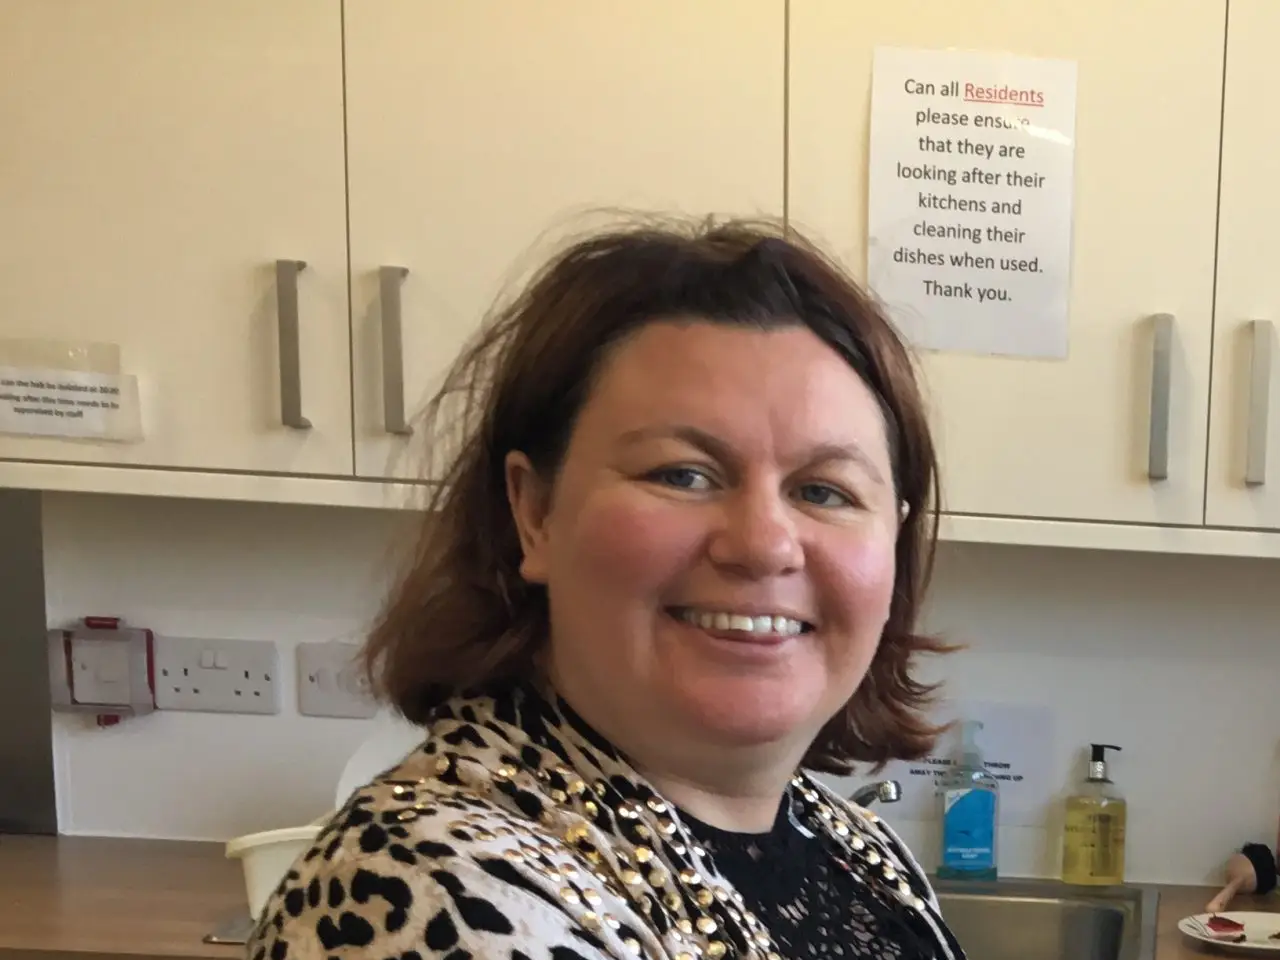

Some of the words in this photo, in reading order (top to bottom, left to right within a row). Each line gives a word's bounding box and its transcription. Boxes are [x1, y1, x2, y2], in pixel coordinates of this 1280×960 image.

[904, 78, 935, 96] Can
[940, 80, 959, 97] all
[964, 83, 1045, 105] Residents
[916, 108, 969, 126] please
[974, 114, 1030, 130] ensue
[918, 136, 952, 153] that
[957, 138, 994, 160] they
[999, 145, 1026, 159] are
[897, 162, 957, 186] looking
[961, 167, 1001, 185] after
[1006, 171, 1046, 188] their
[918, 192, 987, 213] kitchens
[991, 199, 1022, 215] and
[913, 220, 982, 244] cleaning
[986, 225, 1026, 243] their
[893, 247, 945, 266] dishes
[949, 251, 995, 269] when
[1000, 257, 1044, 273] used.
[923, 279, 972, 299] Thank
[977, 287, 1012, 303] you.
